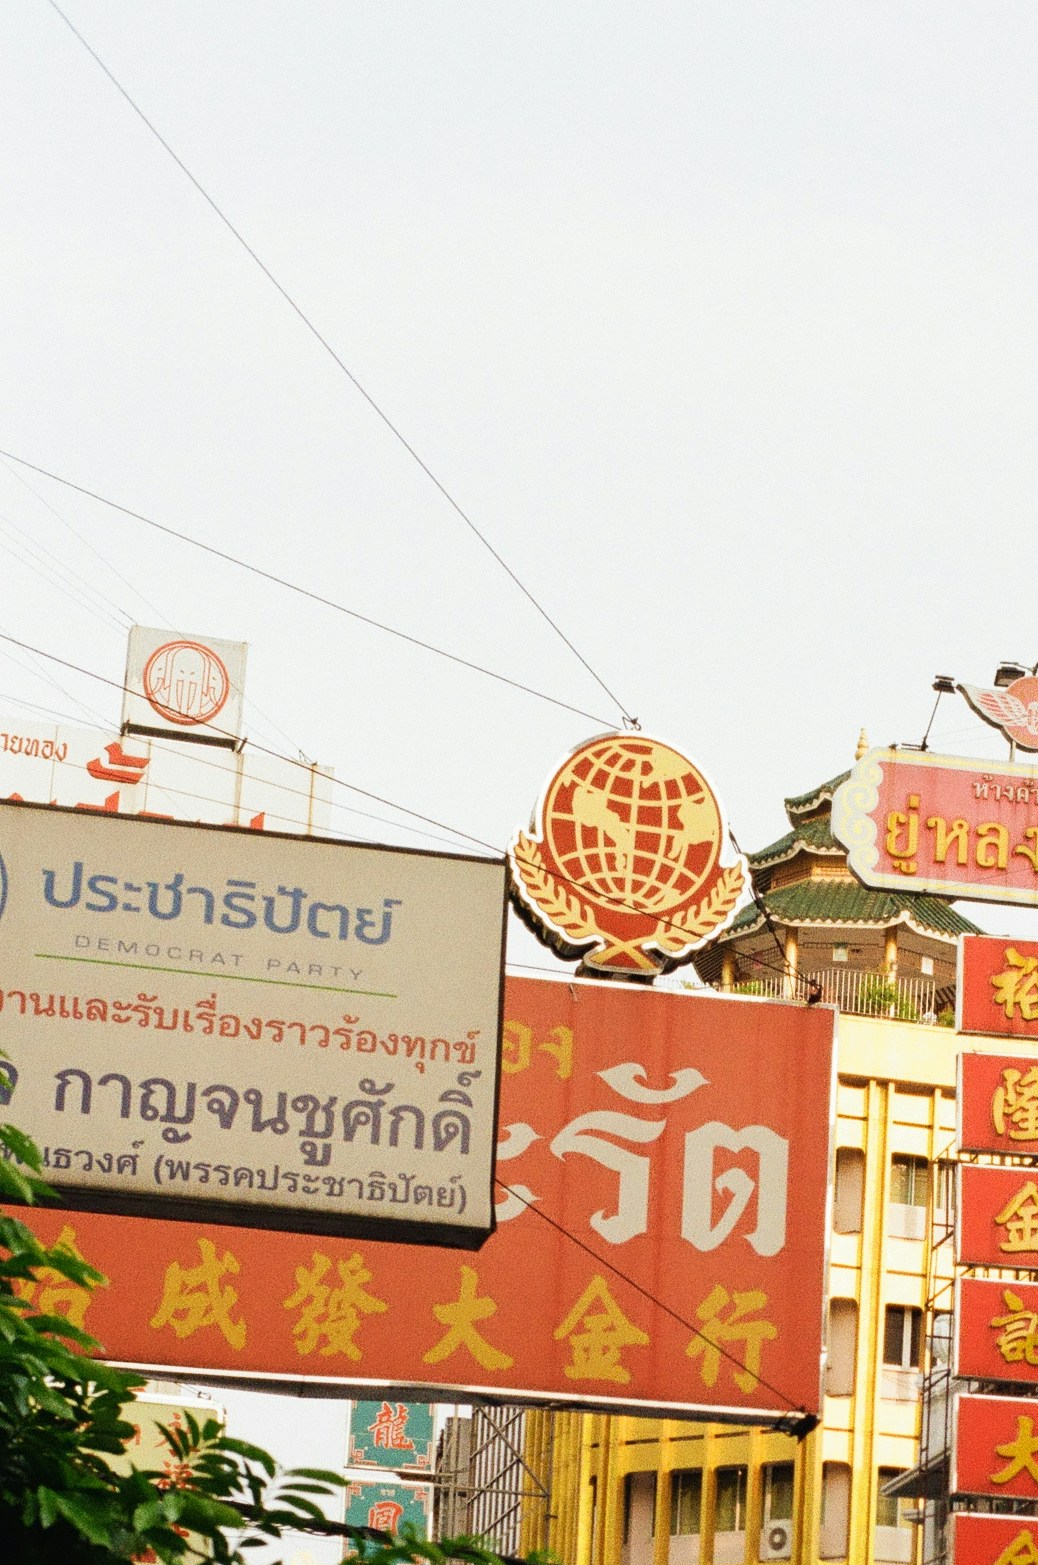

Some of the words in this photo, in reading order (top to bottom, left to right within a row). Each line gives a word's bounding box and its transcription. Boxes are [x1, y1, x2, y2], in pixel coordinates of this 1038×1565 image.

[42, 860, 402, 946] ประชาธิปัตย์
[75, 934, 245, 968] DEMOCRAT
[266, 958, 365, 982] PARTY
[0, 988, 481, 1073] านและรับเรื่องราวร้องทุกข์
[54, 1067, 483, 1168] กาญจนชูศักดิ์
[153, 1152, 468, 1215] (พรรคประชาธิปัตย์)
